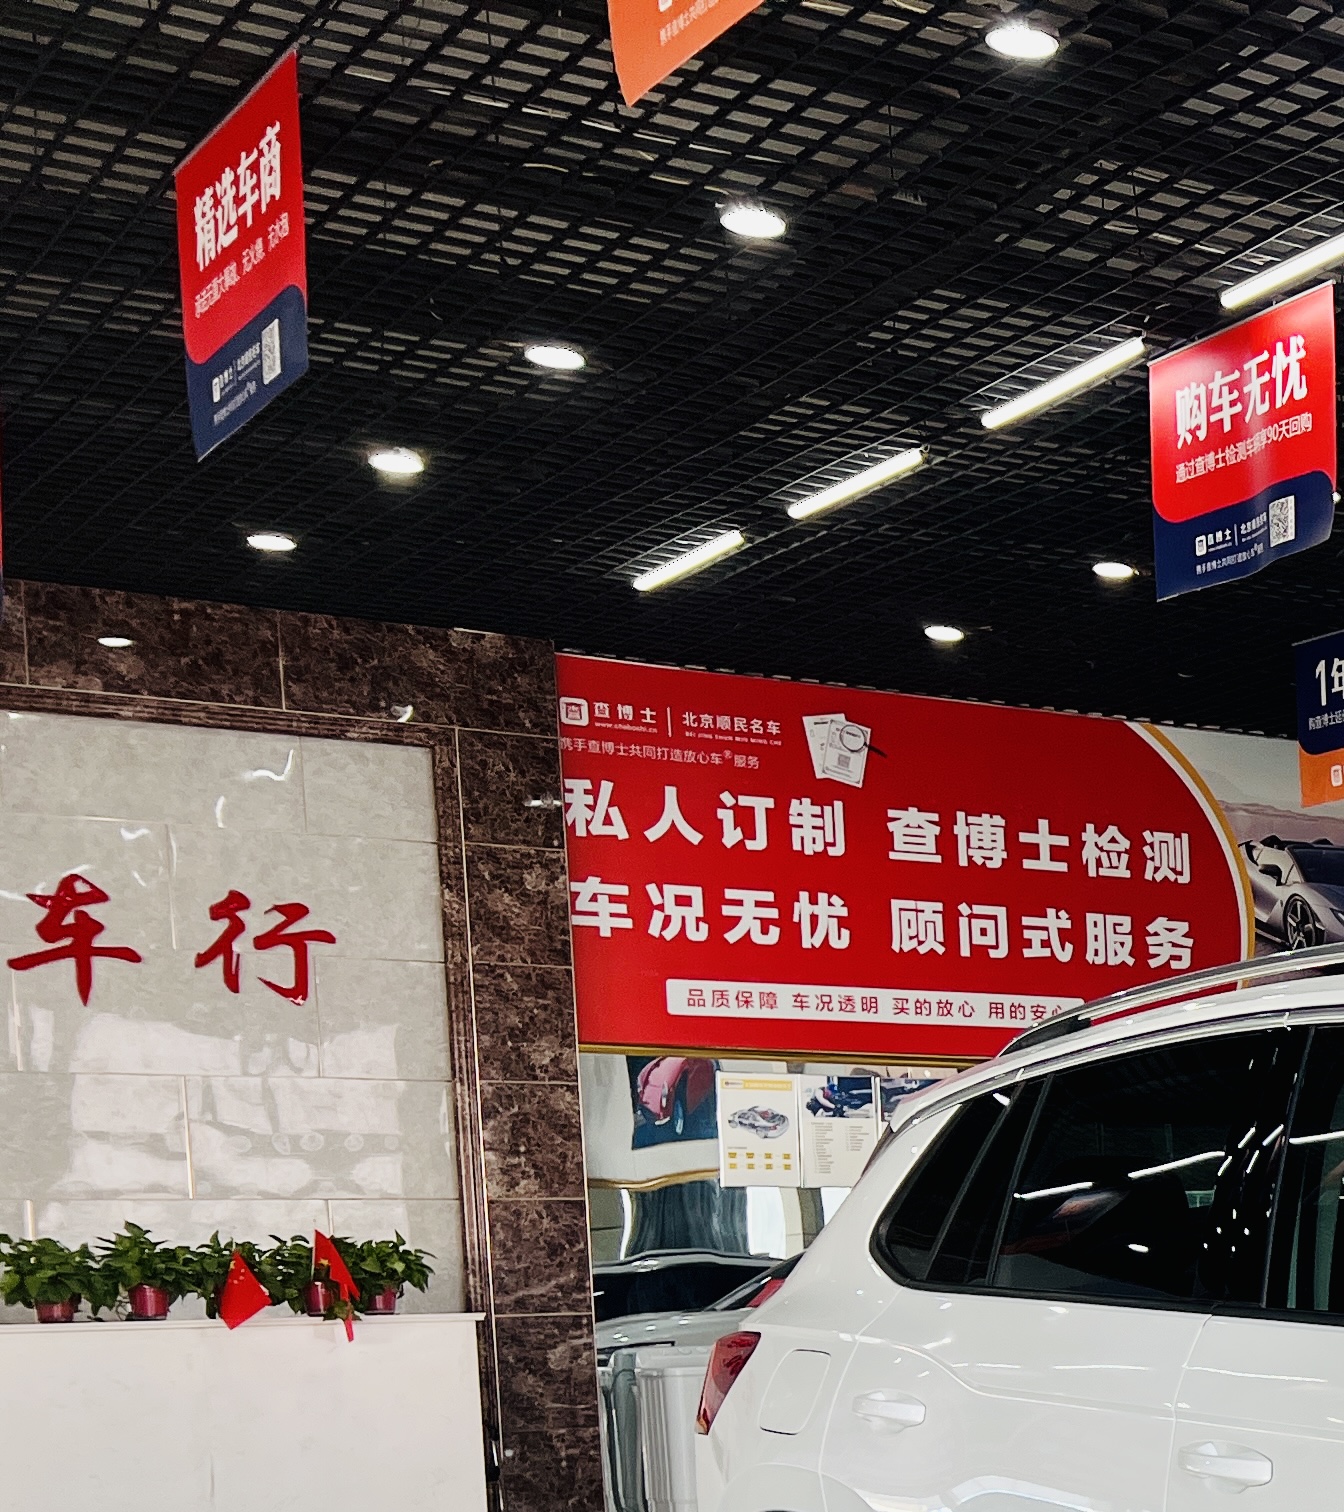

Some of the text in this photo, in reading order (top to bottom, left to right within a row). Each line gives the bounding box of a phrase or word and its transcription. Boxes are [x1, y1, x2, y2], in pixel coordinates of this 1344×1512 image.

[194, 120, 281, 272] 精选车商
[1176, 335, 1308, 449] 购车无忧
[593, 701, 782, 736] 查博士 北京顺民名车
[563, 779, 1192, 885] 私人订制 查博士检测
[7, 873, 337, 1007] 车行
[570, 876, 1195, 970] 车况无忧 顾问式服务
[686, 988, 780, 1011] 品质保障
[791, 992, 879, 1015] 车况透明
[892, 996, 976, 1019] 买的放心
